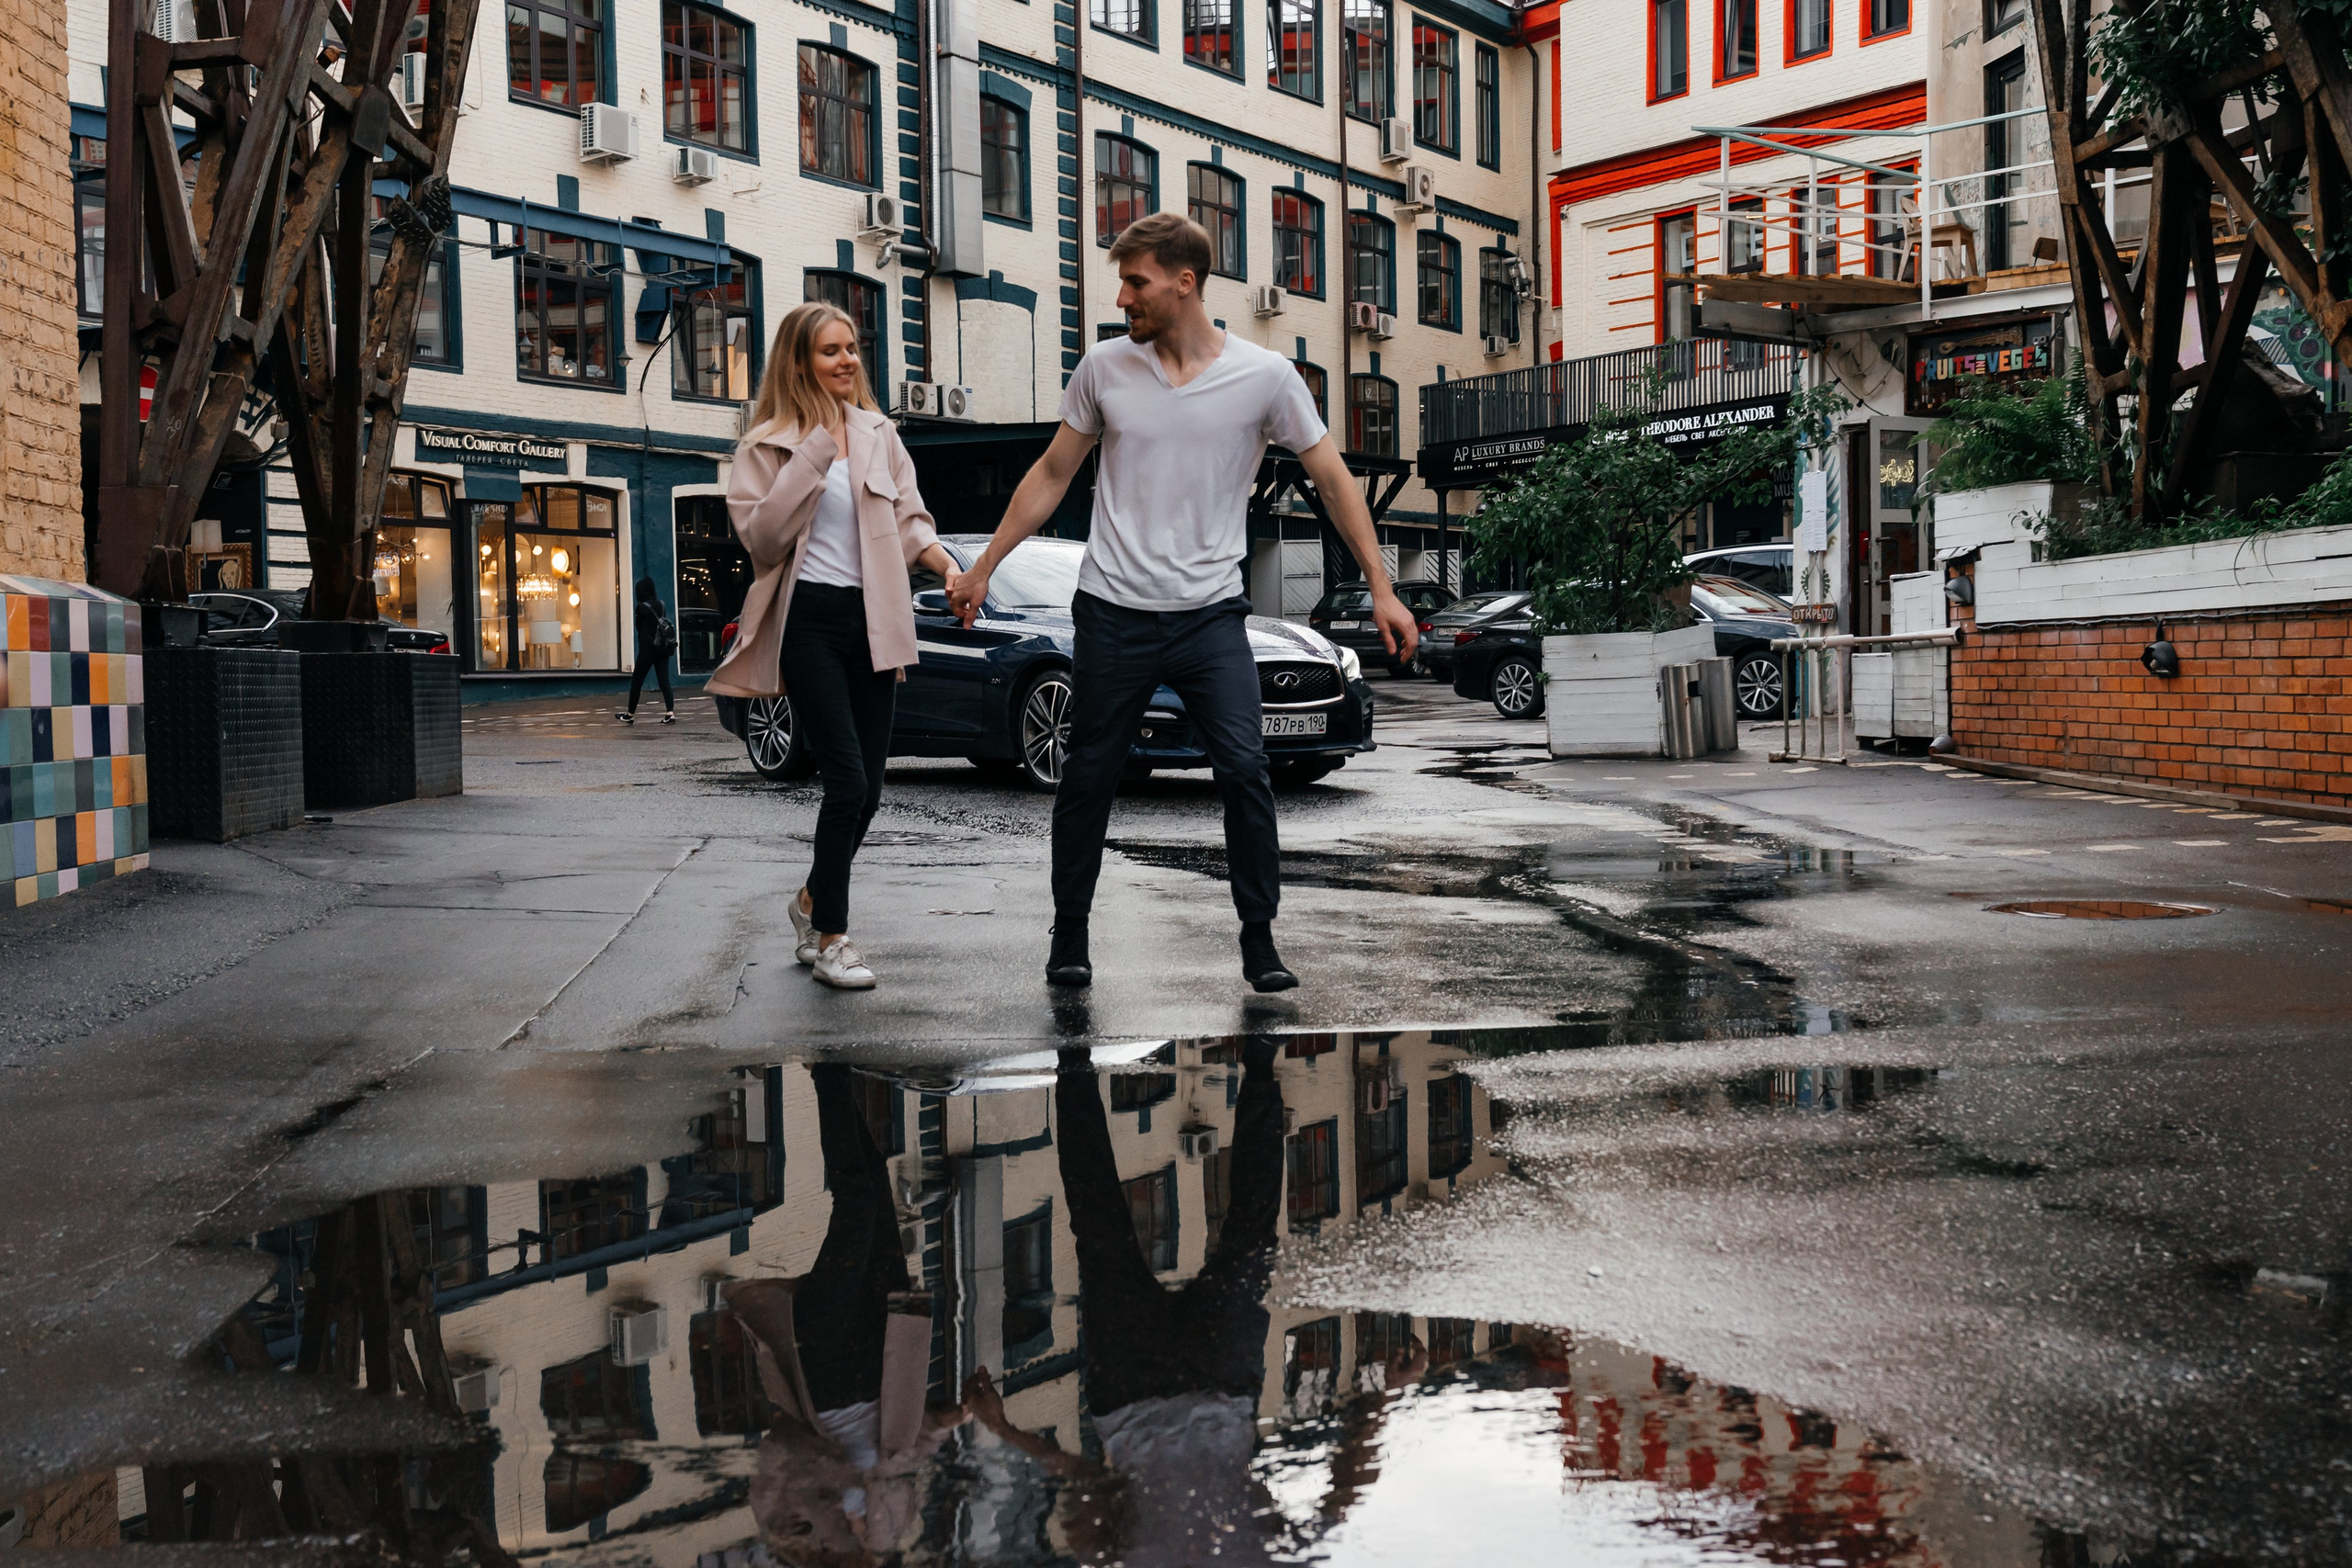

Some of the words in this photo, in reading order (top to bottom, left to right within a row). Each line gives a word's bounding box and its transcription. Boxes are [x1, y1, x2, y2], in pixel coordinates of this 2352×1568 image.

[1916, 355, 1975, 382] FRUITS
[1986, 346, 2047, 373] VEGES
[1641, 415, 1701, 437] THEODORE
[1702, 405, 1775, 428] ALEXANDER
[420, 430, 461, 448] VISUAL
[461, 434, 515, 454] COMFORT
[518, 439, 566, 458] GALLERY
[1690, 432, 1705, 440] СВЕТ
[1453, 446, 1469, 462] AP
[1472, 445, 1506, 458] LUXURY
[1509, 439, 1545, 454] BRANDS
[456, 455, 492, 464] ГАЛЕРЕЯ
[500, 458, 529, 468] СВЕТА
[1793, 608, 1834, 620] ОТКРЫТО
[1261, 717, 1305, 733] 787РВ
[1307, 716, 1323, 727] 190
